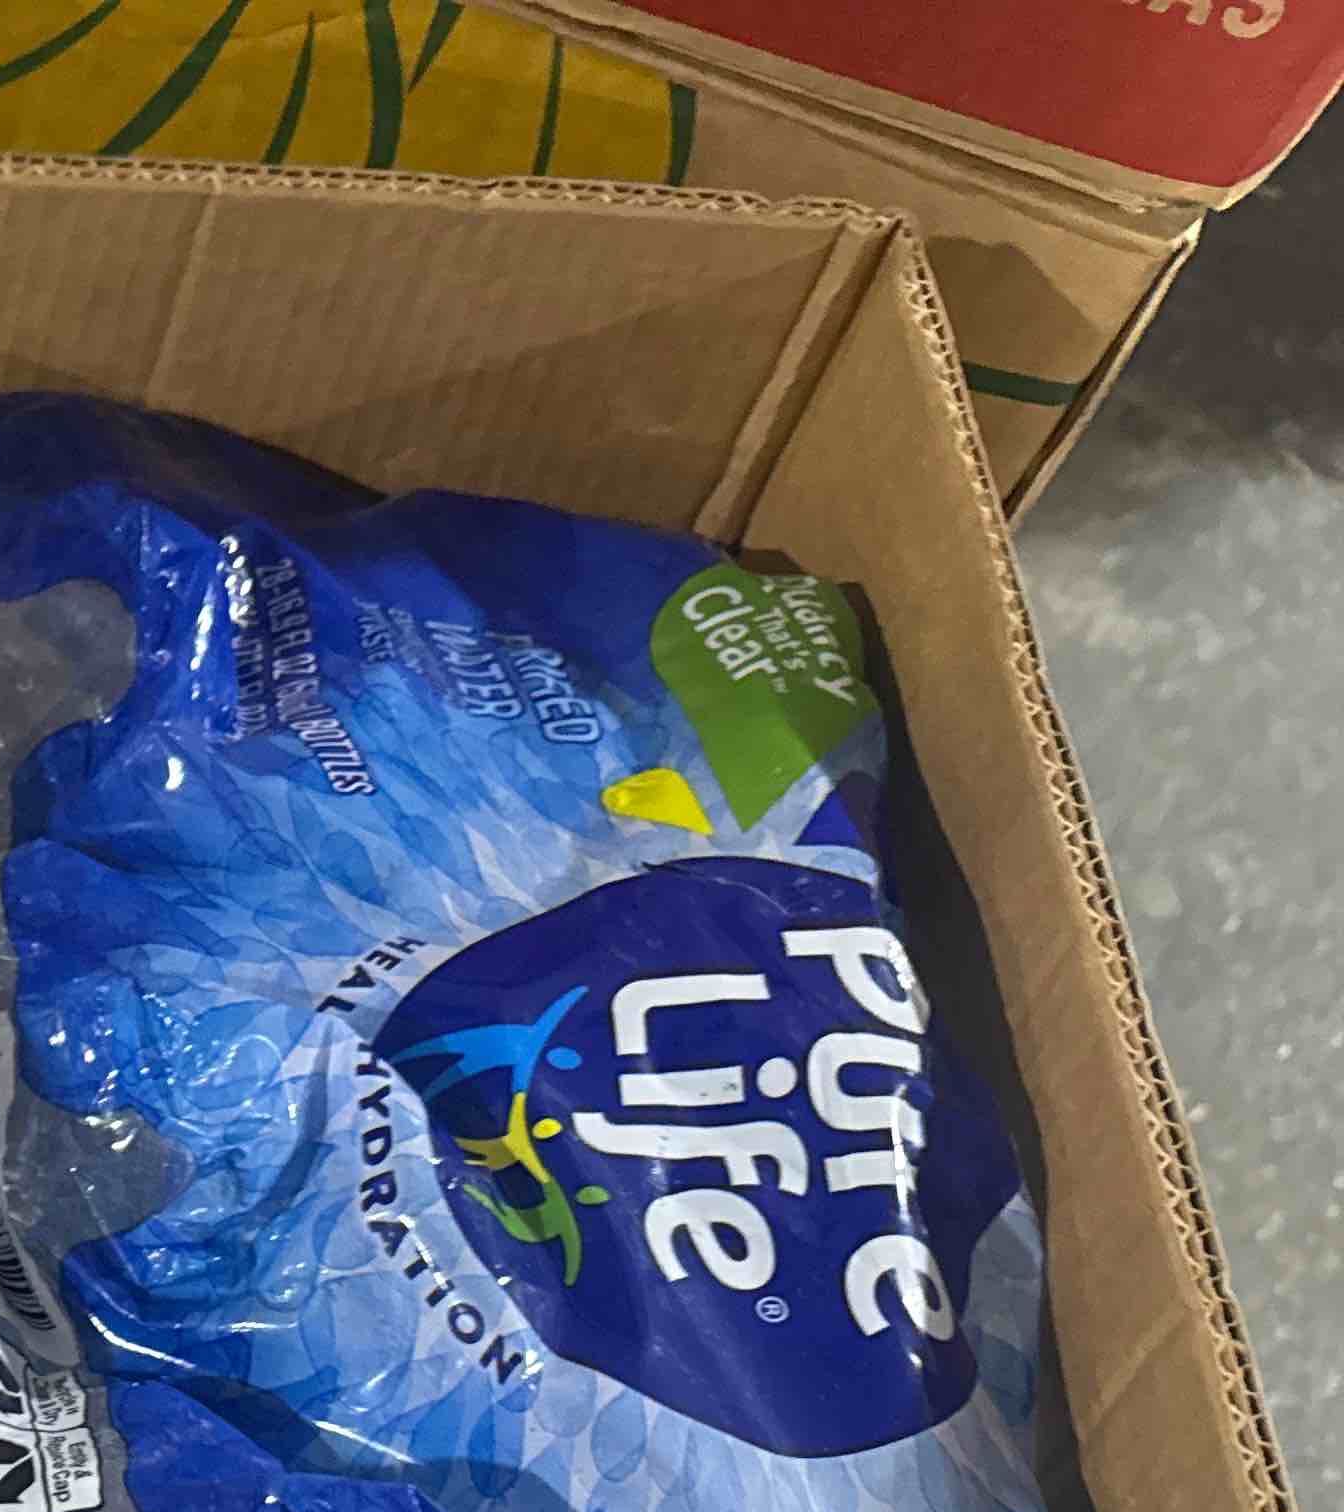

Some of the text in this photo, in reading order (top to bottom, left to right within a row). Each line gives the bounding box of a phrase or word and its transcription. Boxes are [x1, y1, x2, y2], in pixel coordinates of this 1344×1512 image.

[682, 586, 778, 681] Clear
[317, 936, 525, 1386] HEAL HYDRATION
[573, 975, 808, 1292] Life
[782, 926, 953, 1342] Pure
[46, 1469, 76, 1504] Cap
